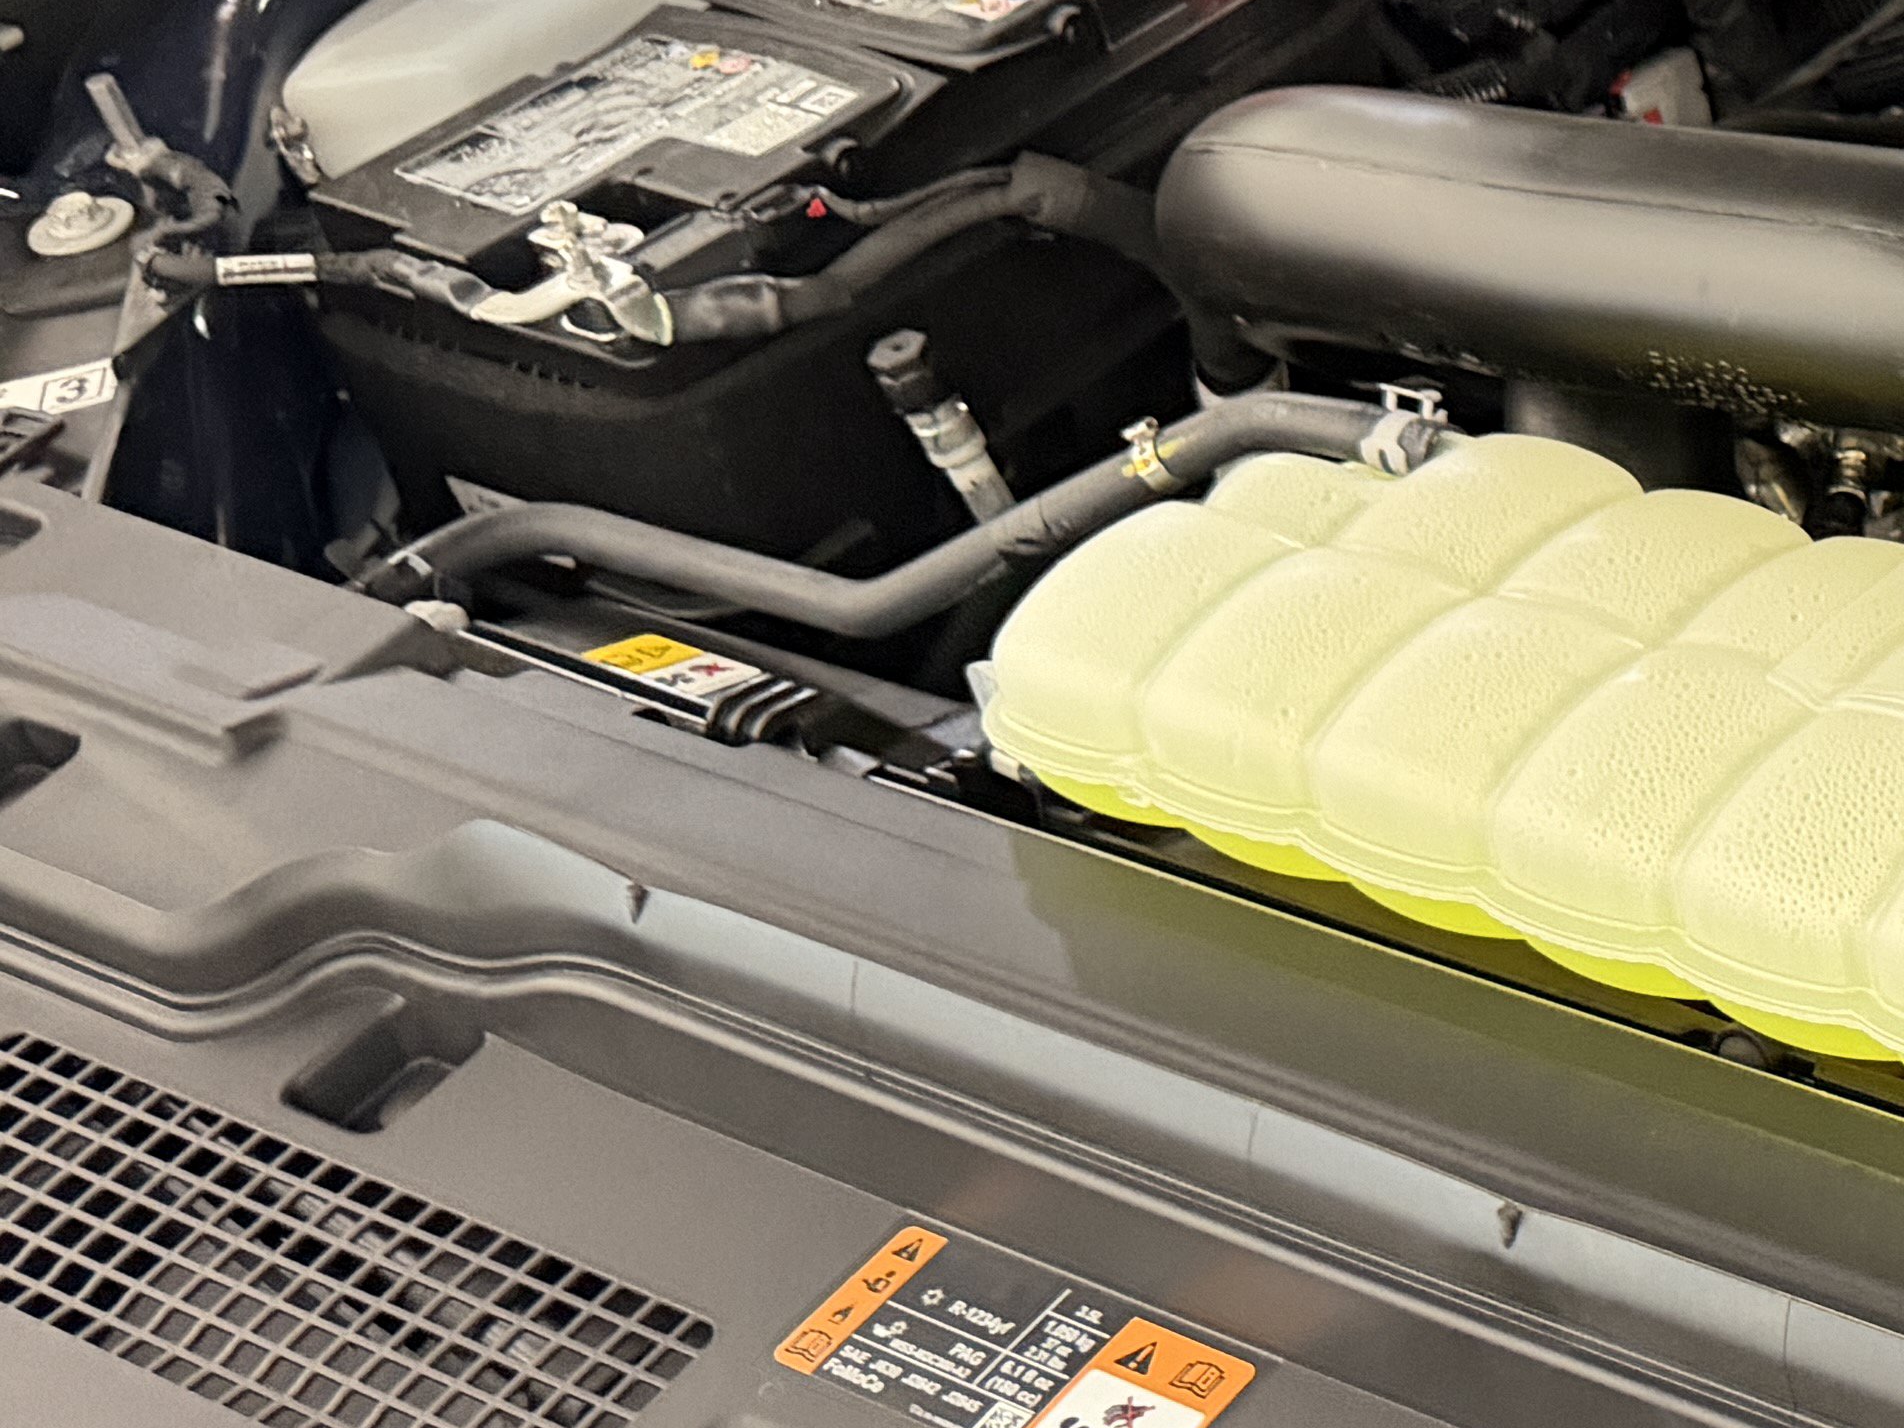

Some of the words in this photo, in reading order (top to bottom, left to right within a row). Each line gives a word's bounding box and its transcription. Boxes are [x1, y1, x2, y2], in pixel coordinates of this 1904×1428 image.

[56, 376, 88, 404] 3
[948, 1300, 1017, 1336] R-1234yf
[838, 1344, 873, 1365] SAE
[948, 1342, 987, 1366] PAG
[822, 1357, 886, 1394] FoMoCo
